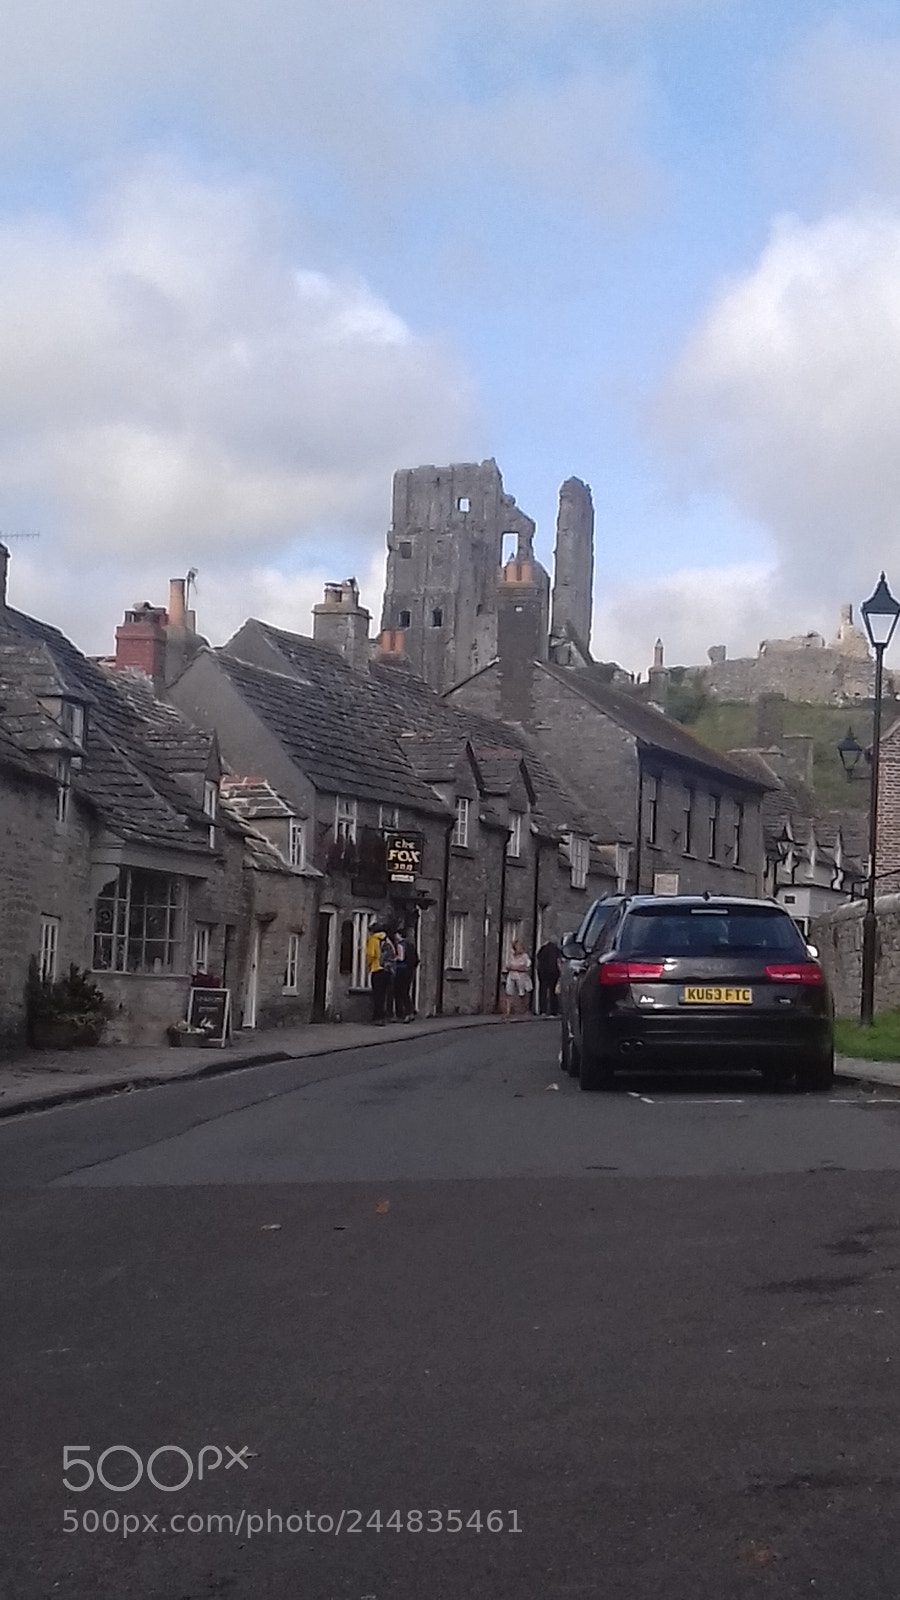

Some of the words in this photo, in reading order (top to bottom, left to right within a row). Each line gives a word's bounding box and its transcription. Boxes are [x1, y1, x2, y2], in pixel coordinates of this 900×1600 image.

[388, 850, 420, 862] FOX
[687, 988, 722, 1000] KU63
[725, 988, 750, 1001] FTC
